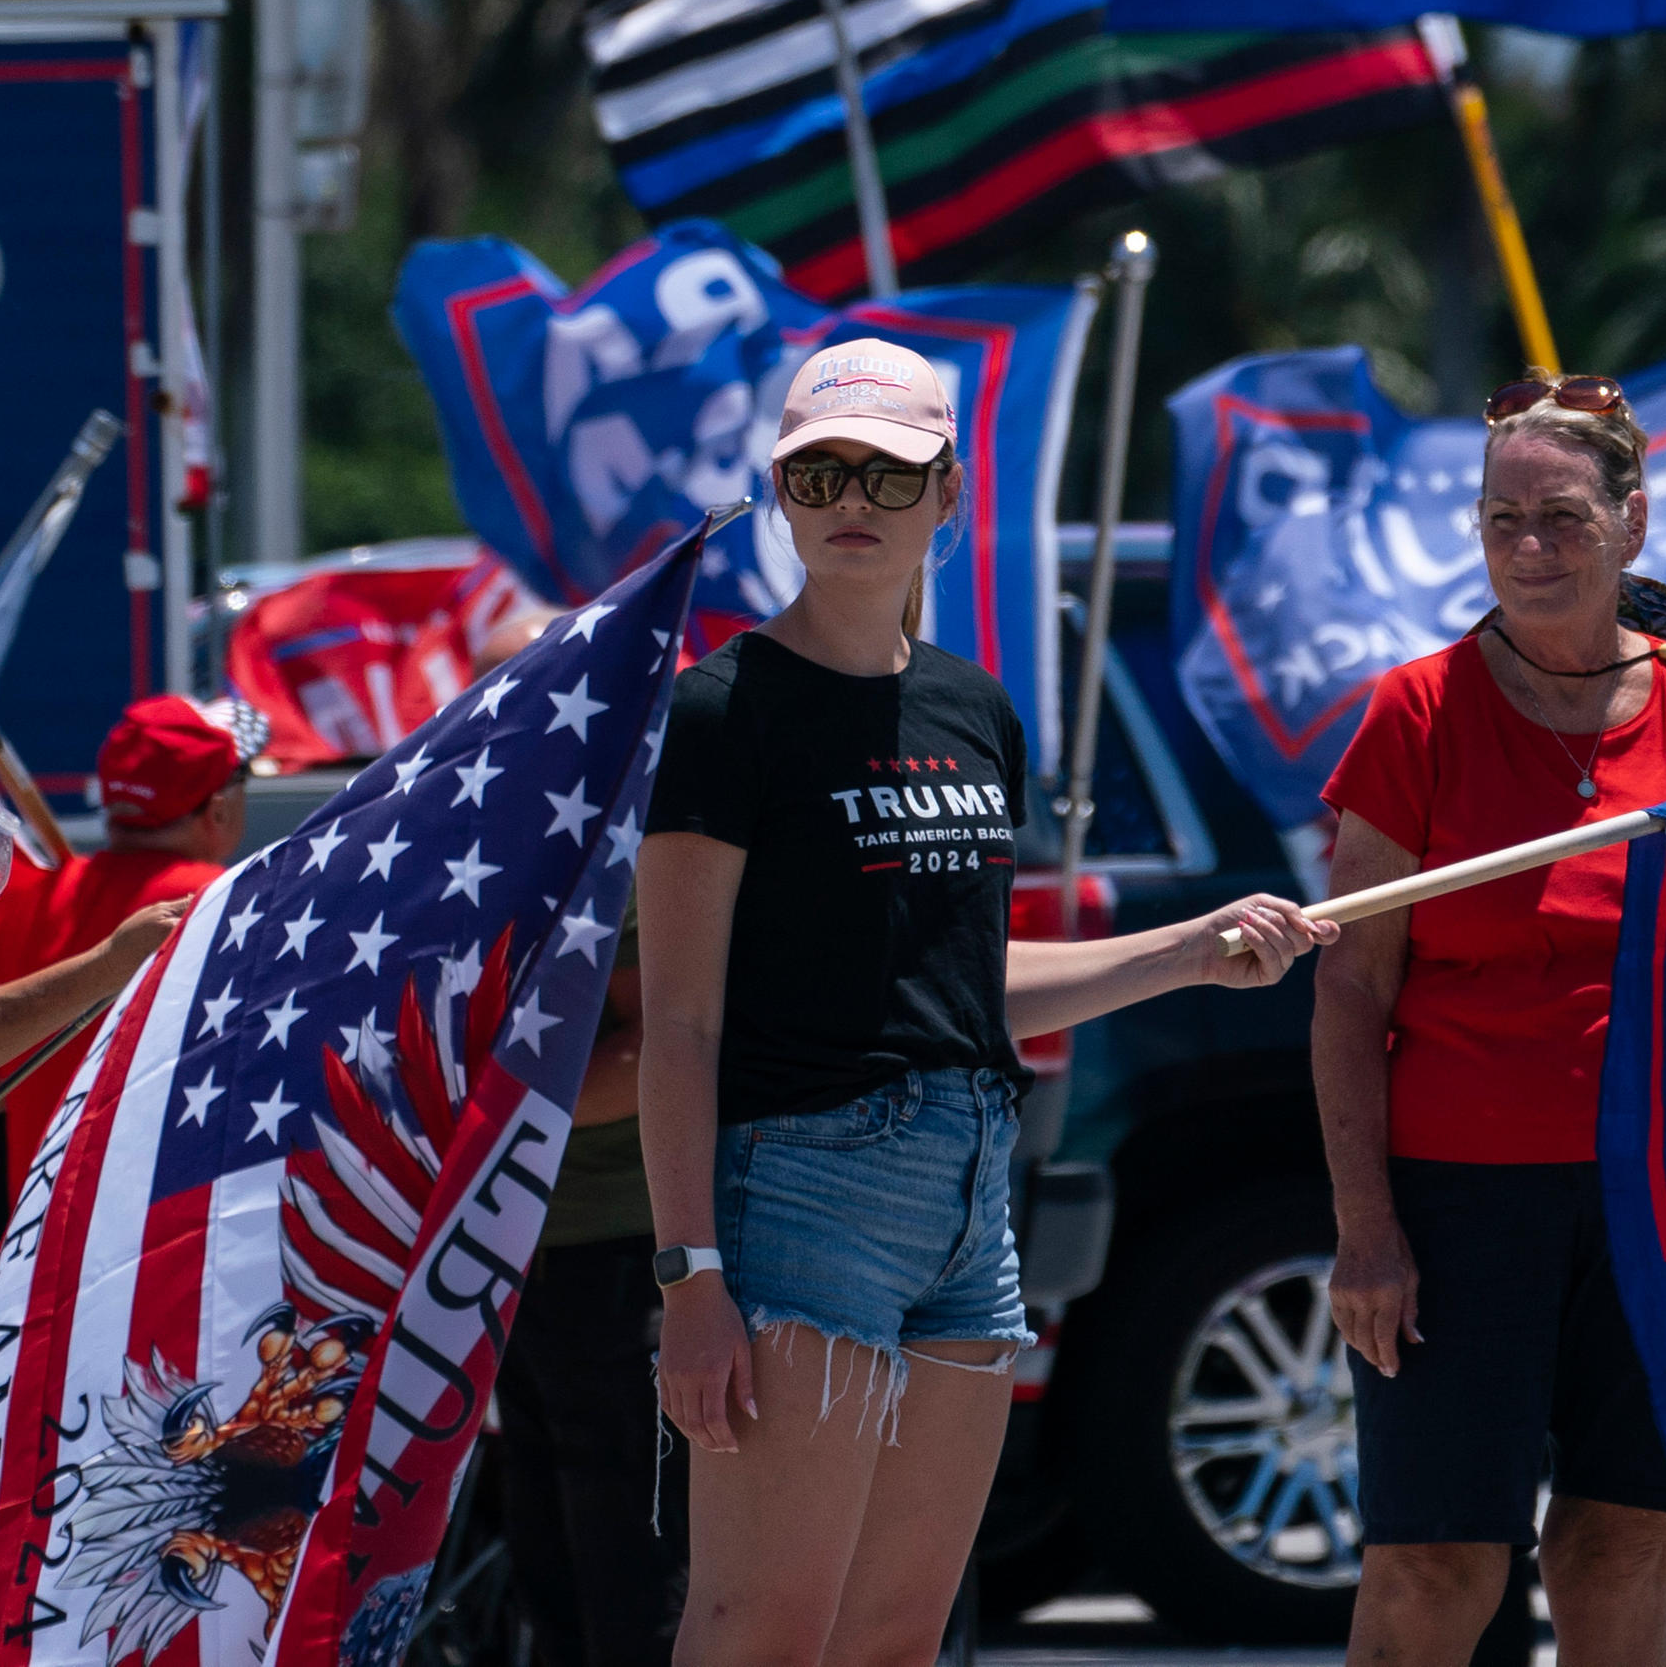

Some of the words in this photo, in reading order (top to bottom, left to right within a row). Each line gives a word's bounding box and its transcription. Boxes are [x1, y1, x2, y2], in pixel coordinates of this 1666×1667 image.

[816, 356, 915, 382] Trump
[837, 384, 882, 398] 2024
[830, 784, 1006, 823] TRUMP
[854, 831, 900, 849] TAKE
[905, 828, 973, 843] AMERICA
[909, 850, 981, 874] 2024
[4, 1393, 91, 1647] 2024
